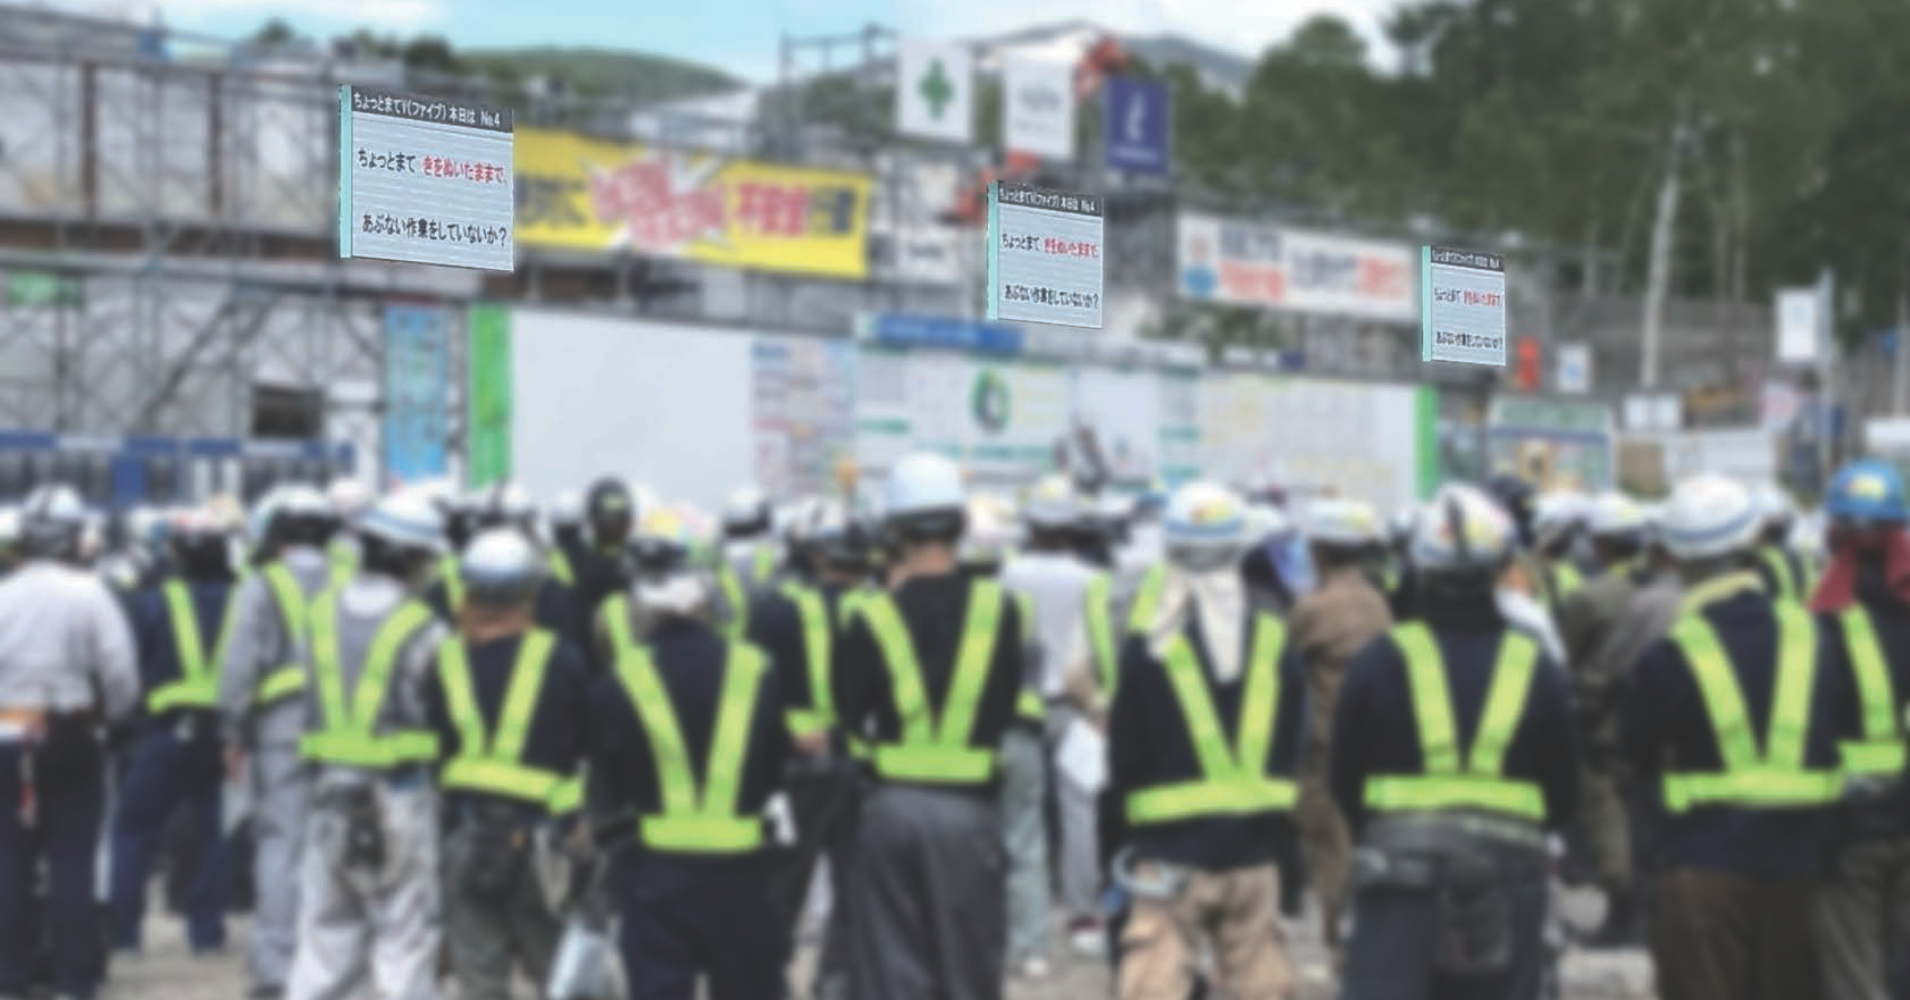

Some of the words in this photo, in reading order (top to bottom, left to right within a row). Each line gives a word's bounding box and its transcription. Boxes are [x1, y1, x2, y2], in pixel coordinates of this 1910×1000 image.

[450, 106, 476, 124] 本日は
[358, 148, 416, 173] ちょっとまて
